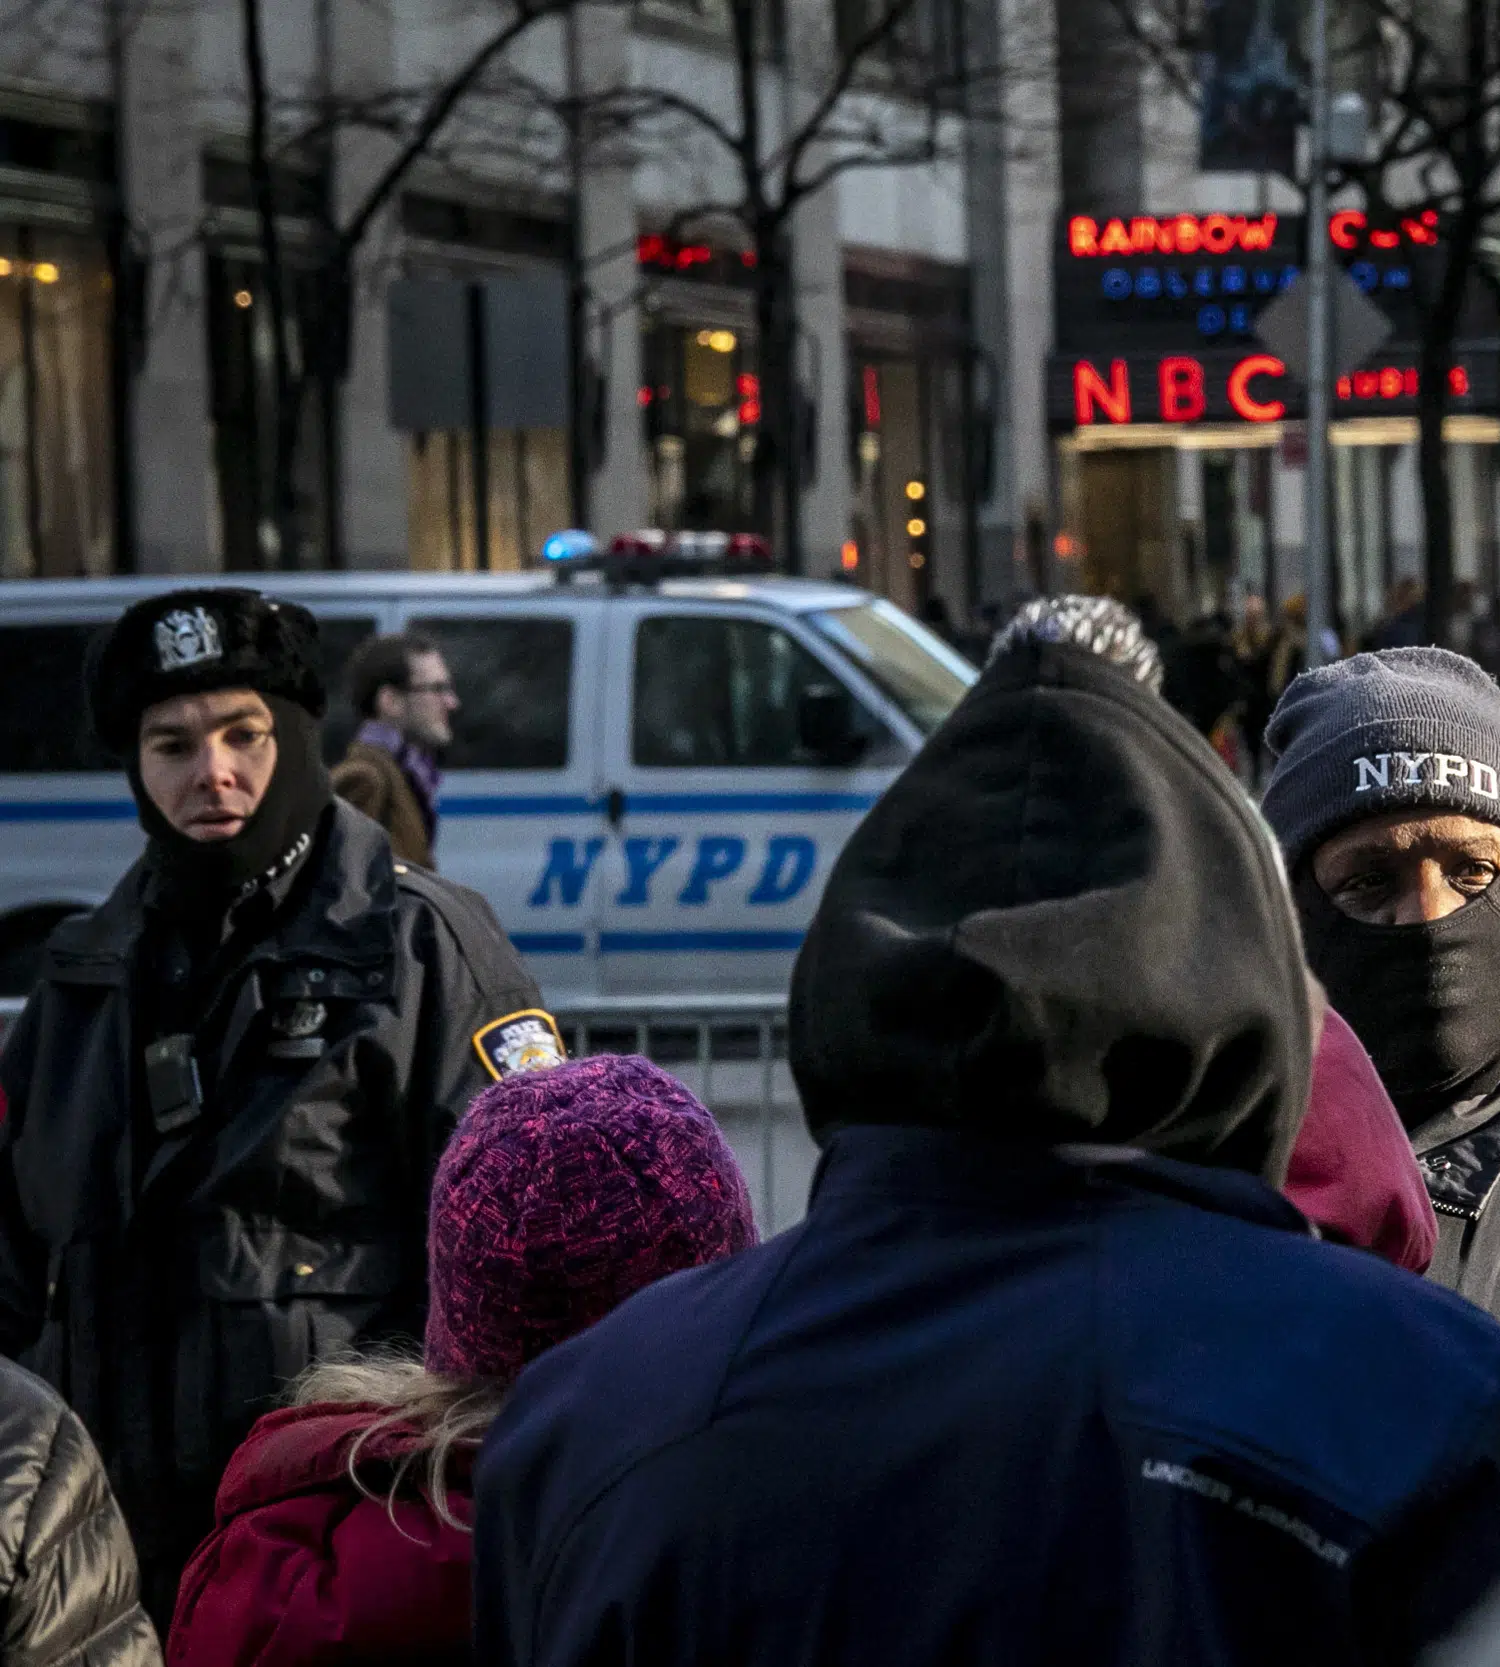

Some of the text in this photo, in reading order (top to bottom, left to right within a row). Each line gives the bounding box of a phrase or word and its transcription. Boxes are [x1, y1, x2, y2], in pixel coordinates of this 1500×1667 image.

[1069, 213, 1277, 257] RAINBOW
[1073, 354, 1285, 425] NBC
[1353, 751, 1499, 800] NYPD
[529, 835, 817, 906] NYPD
